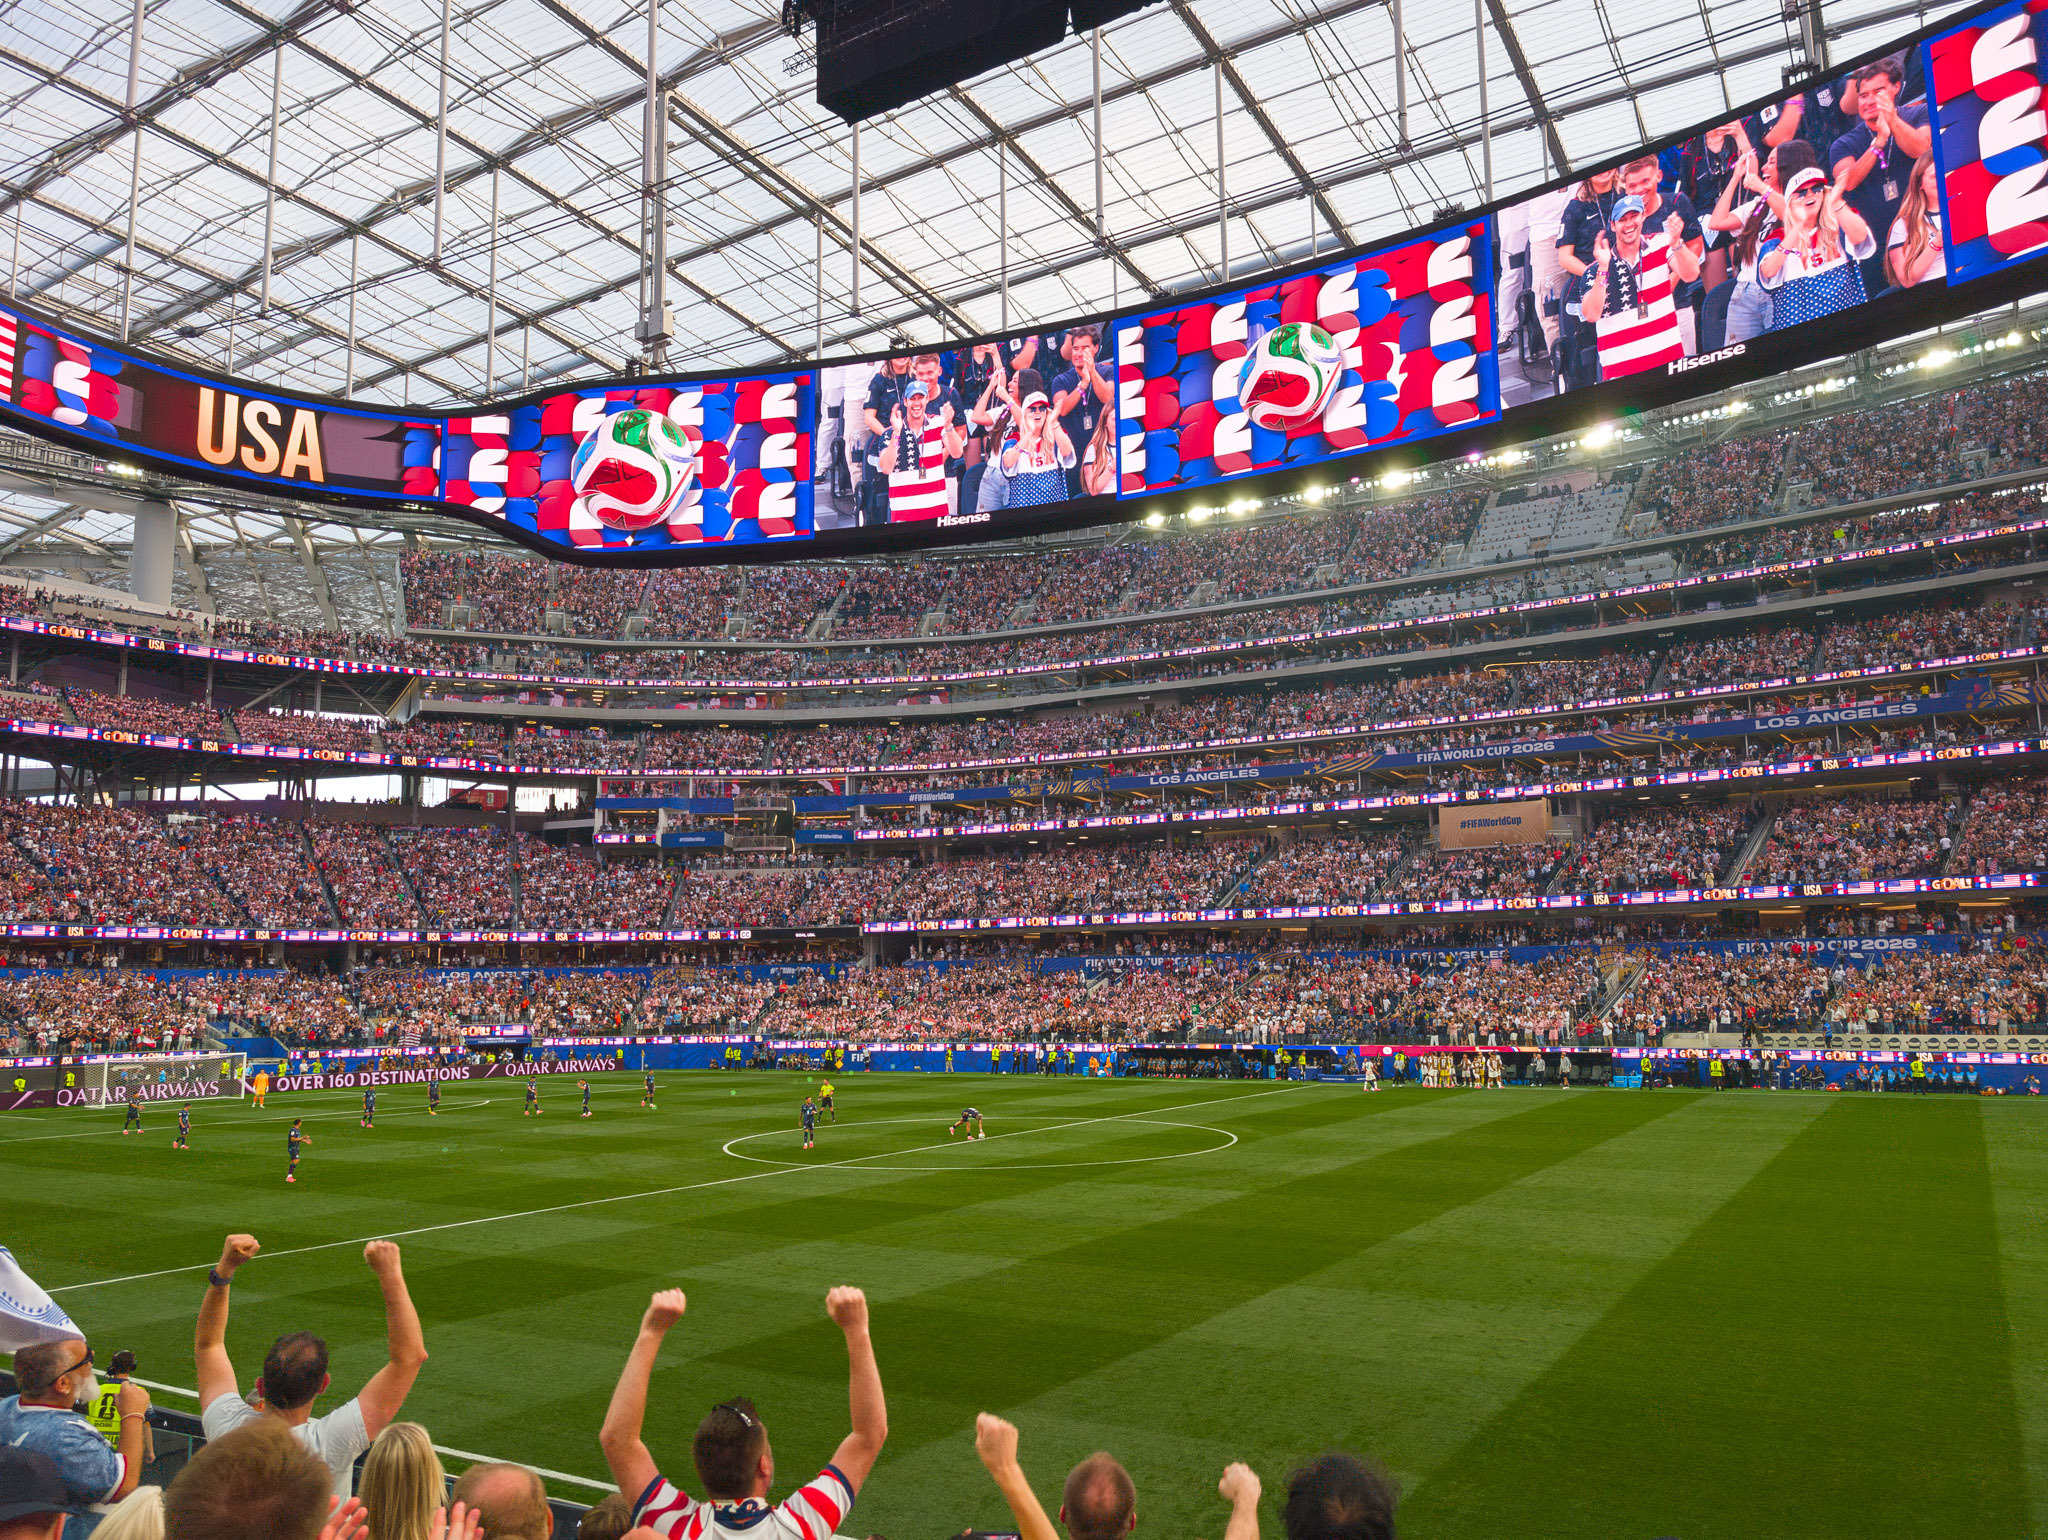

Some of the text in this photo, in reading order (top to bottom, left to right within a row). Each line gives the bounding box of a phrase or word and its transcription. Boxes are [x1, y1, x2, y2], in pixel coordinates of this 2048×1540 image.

[1668, 344, 1746, 375] Hisense
[197, 387, 324, 482] USA
[937, 513, 990, 527] Hisense
[1994, 526, 2018, 534] GOAL!
[48, 626, 86, 638] GOAL!
[148, 640, 166, 650] USA
[258, 654, 290, 666] GOAL!
[1976, 652, 2000, 660] GOAL!
[1838, 670, 1862, 678] GOAL!
[1754, 704, 1918, 729] LOS ANGELES
[102, 730, 140, 744] GOAL!
[202, 740, 218, 752] USA
[314, 750, 346, 760] GOAL!
[1417, 742, 1555, 763] FIFA WORLD CUP 2026
[1936, 748, 1972, 760] GOAL!
[400, 756, 418, 766] USA
[1732, 766, 1764, 778] GOAL!
[1149, 769, 1260, 786] LOS ANGELES
[1632, 776, 1648, 786] USA
[1554, 782, 1582, 792] GOAL!
[909, 792, 954, 802] #FIFAWorldCup
[1466, 790, 1480, 800] USA
[1394, 796, 1420, 806] GOAL!
[1246, 806, 1270, 816] GOAL!
[1312, 804, 1326, 812] USA
[1110, 816, 1134, 824] GOAL!
[1172, 814, 1184, 822] USA
[1460, 816, 1522, 829] #FIFAWorldCup
[886, 830, 908, 838] GOAL!
[1932, 878, 1972, 890] GOAL!
[1704, 888, 1738, 900] GOAL!
[1804, 884, 1822, 896] USA
[1506, 898, 1536, 908] GOAL!
[1592, 894, 1610, 904] USA
[1330, 906, 1358, 916] GOAL!
[1408, 902, 1424, 912] USA
[1172, 912, 1196, 920] GOAL!
[1242, 910, 1256, 918] USA
[978, 920, 992, 928] USA
[1024, 918, 1050, 926] GOAL!
[1092, 916, 1104, 924] USA
[68, 926, 84, 936] USA
[916, 922, 940, 930] GOAL!
[172, 926, 204, 938] GOAL!
[254, 930, 270, 940] USA
[350, 932, 378, 940] GOAL!
[426, 932, 440, 942] USA
[482, 932, 508, 940] GOAL!
[638, 932, 664, 940] GOAL!
[708, 932, 722, 940] USA
[1861, 938, 1917, 950] 2026
[460, 1026, 490, 1036] GOAL!
[1825, 1050, 1857, 1061] GOAL!
[505, 1058, 616, 1077] QATAR AIRWAYS
[277, 1067, 470, 1091] OVER 160 DESTINATIONS
[57, 1080, 219, 1106] QATAR AIRWAYS
